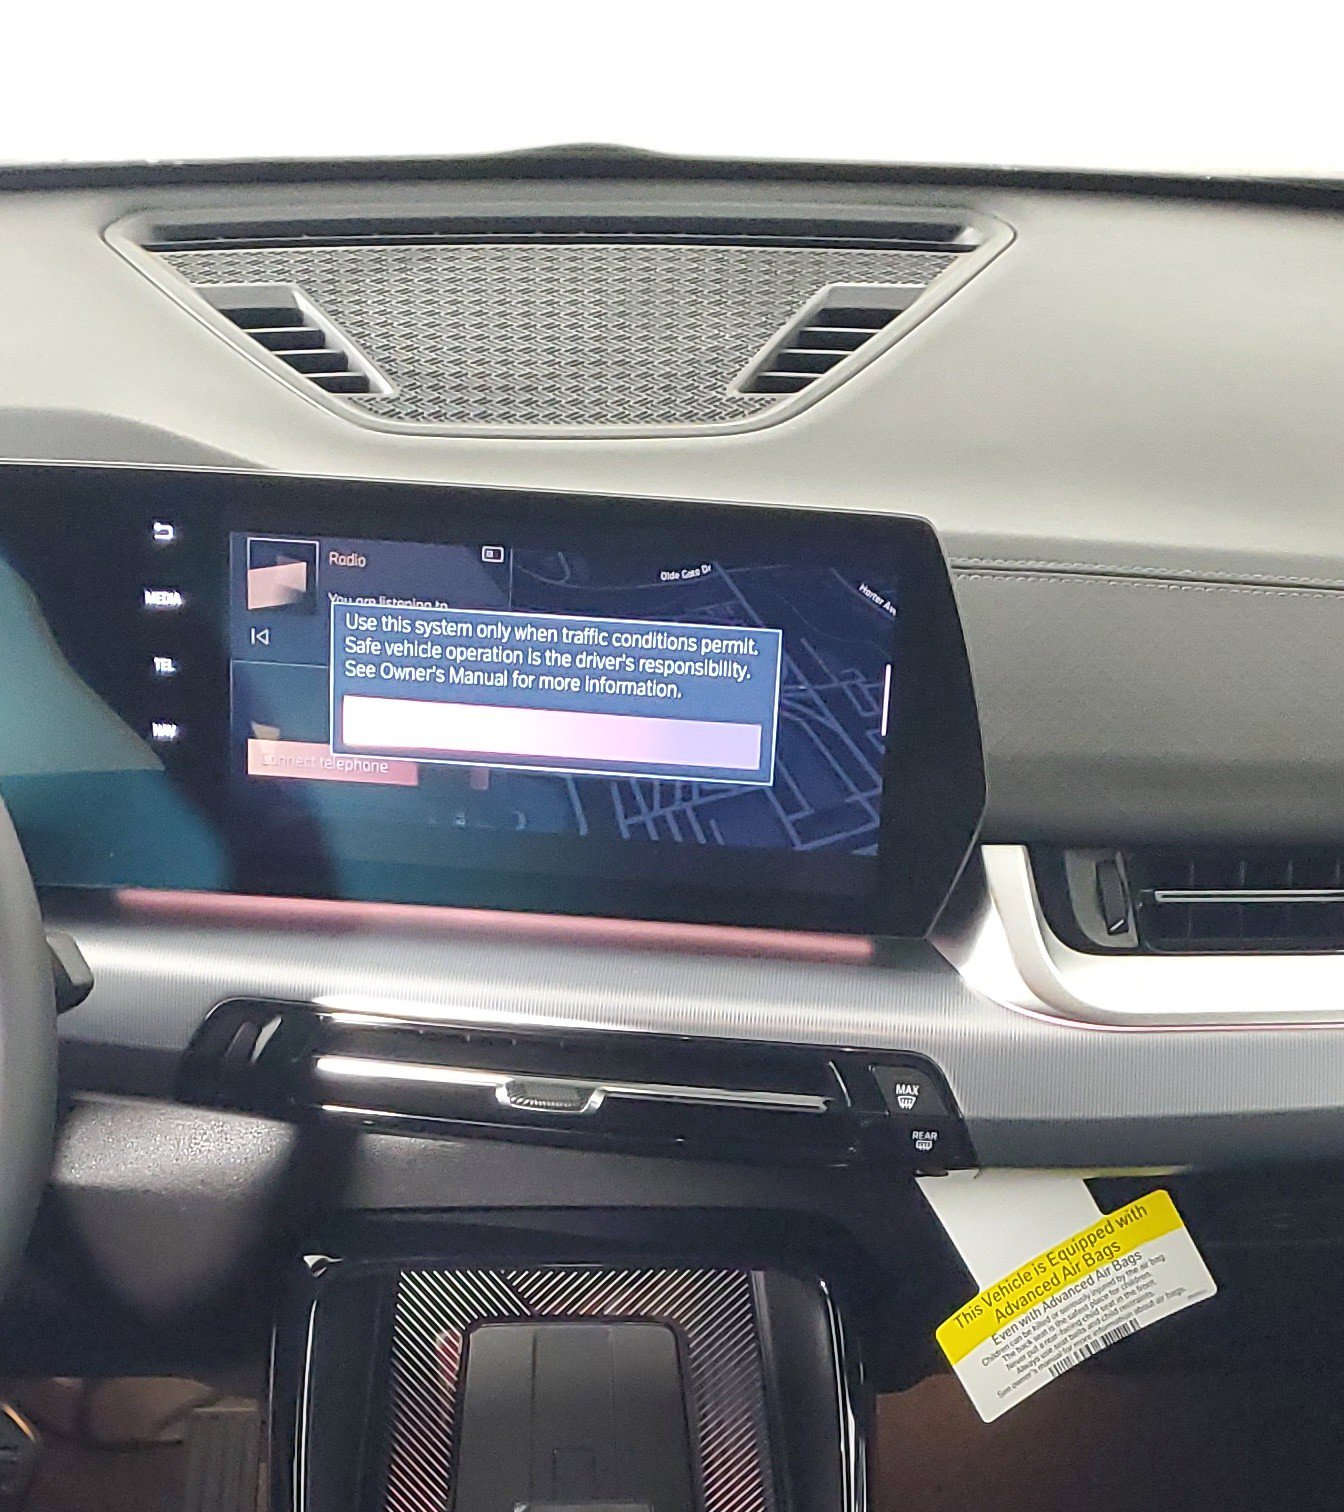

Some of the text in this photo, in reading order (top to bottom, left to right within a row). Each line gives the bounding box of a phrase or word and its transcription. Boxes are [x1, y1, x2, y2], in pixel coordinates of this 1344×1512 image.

[329, 551, 367, 568] Radio
[345, 613, 759, 657] Use this system only when traffic conditions permit.
[345, 636, 751, 683] Safe vehicle operation is the driver's responsibility.
[345, 660, 682, 699] See Owner's Manual for more information.
[319, 757, 388, 773] telephone
[896, 1083, 920, 1096] MAX
[912, 1131, 938, 1141] REAR
[954, 1202, 1148, 1329] This Vehicle is Equipped with
[995, 1239, 1122, 1324] Advanced Air Bags
[991, 1249, 1143, 1346] Even with Advanced Air Bags
[1009, 1335, 1023, 1347] can
[1022, 1329, 1032, 1338] be
[1115, 1273, 1126, 1285] by
[1125, 1265, 1139, 1277] the
[1081, 1308, 1100, 1322] child
[1123, 1288, 1137, 1300] the
[1002, 1350, 1016, 1361] The
[1015, 1339, 1033, 1353] back
[1054, 1317, 1068, 1328] the
[1086, 1318, 1101, 1330] and
[1100, 1308, 1119, 1322] child
